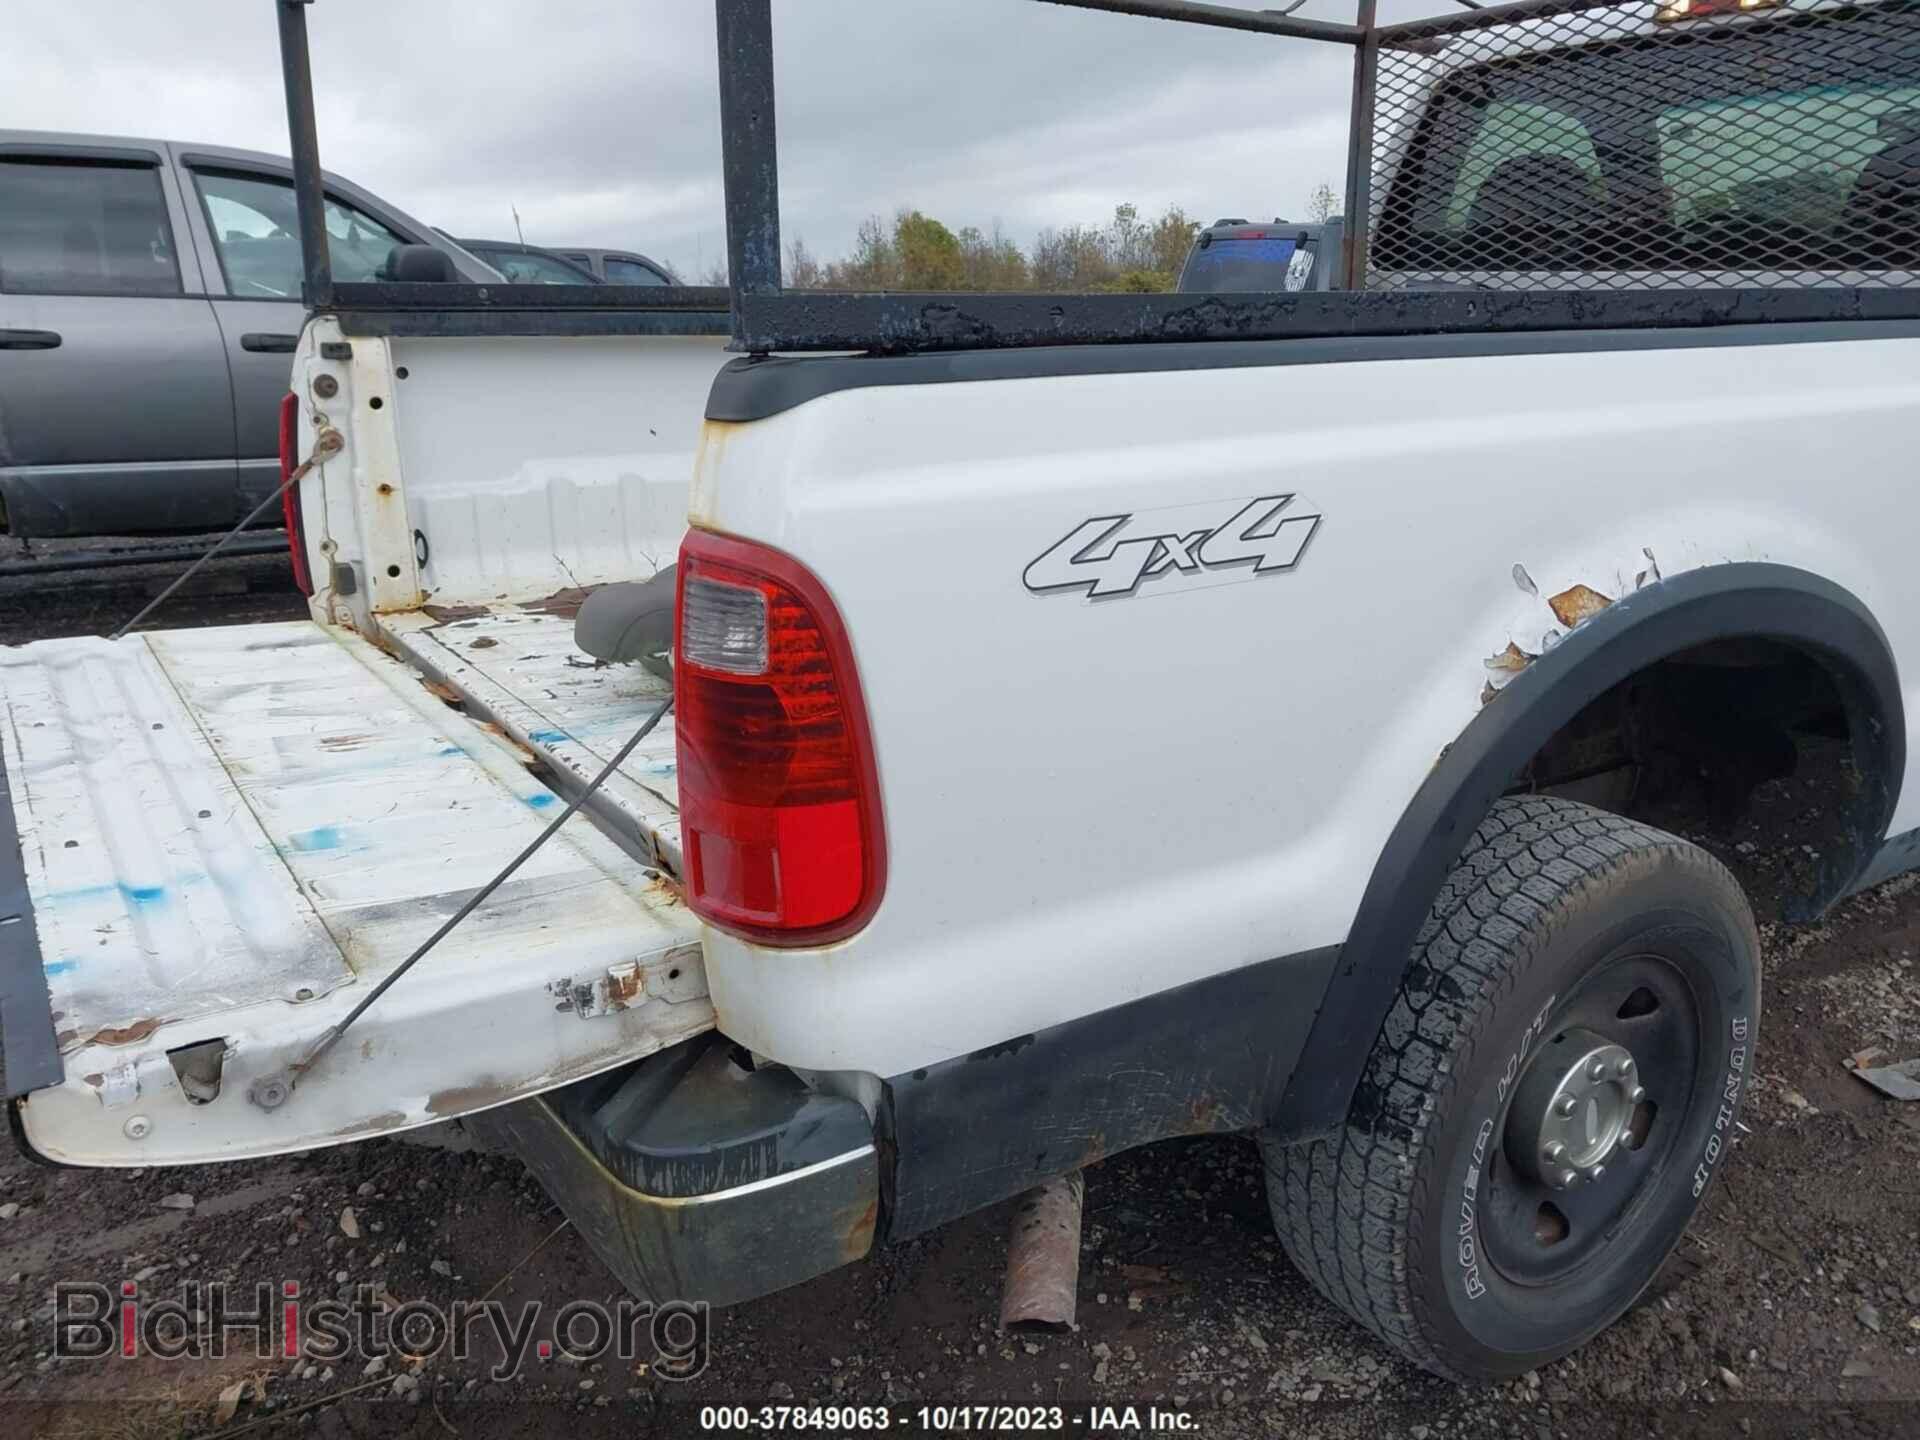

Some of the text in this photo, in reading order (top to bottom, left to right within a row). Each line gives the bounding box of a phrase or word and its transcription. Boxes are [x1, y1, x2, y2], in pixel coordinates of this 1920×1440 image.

[1022, 493, 1322, 604] 4x4
[1692, 1016, 1748, 1198] DUNLOP
[1459, 1118, 1494, 1299] ROVER
